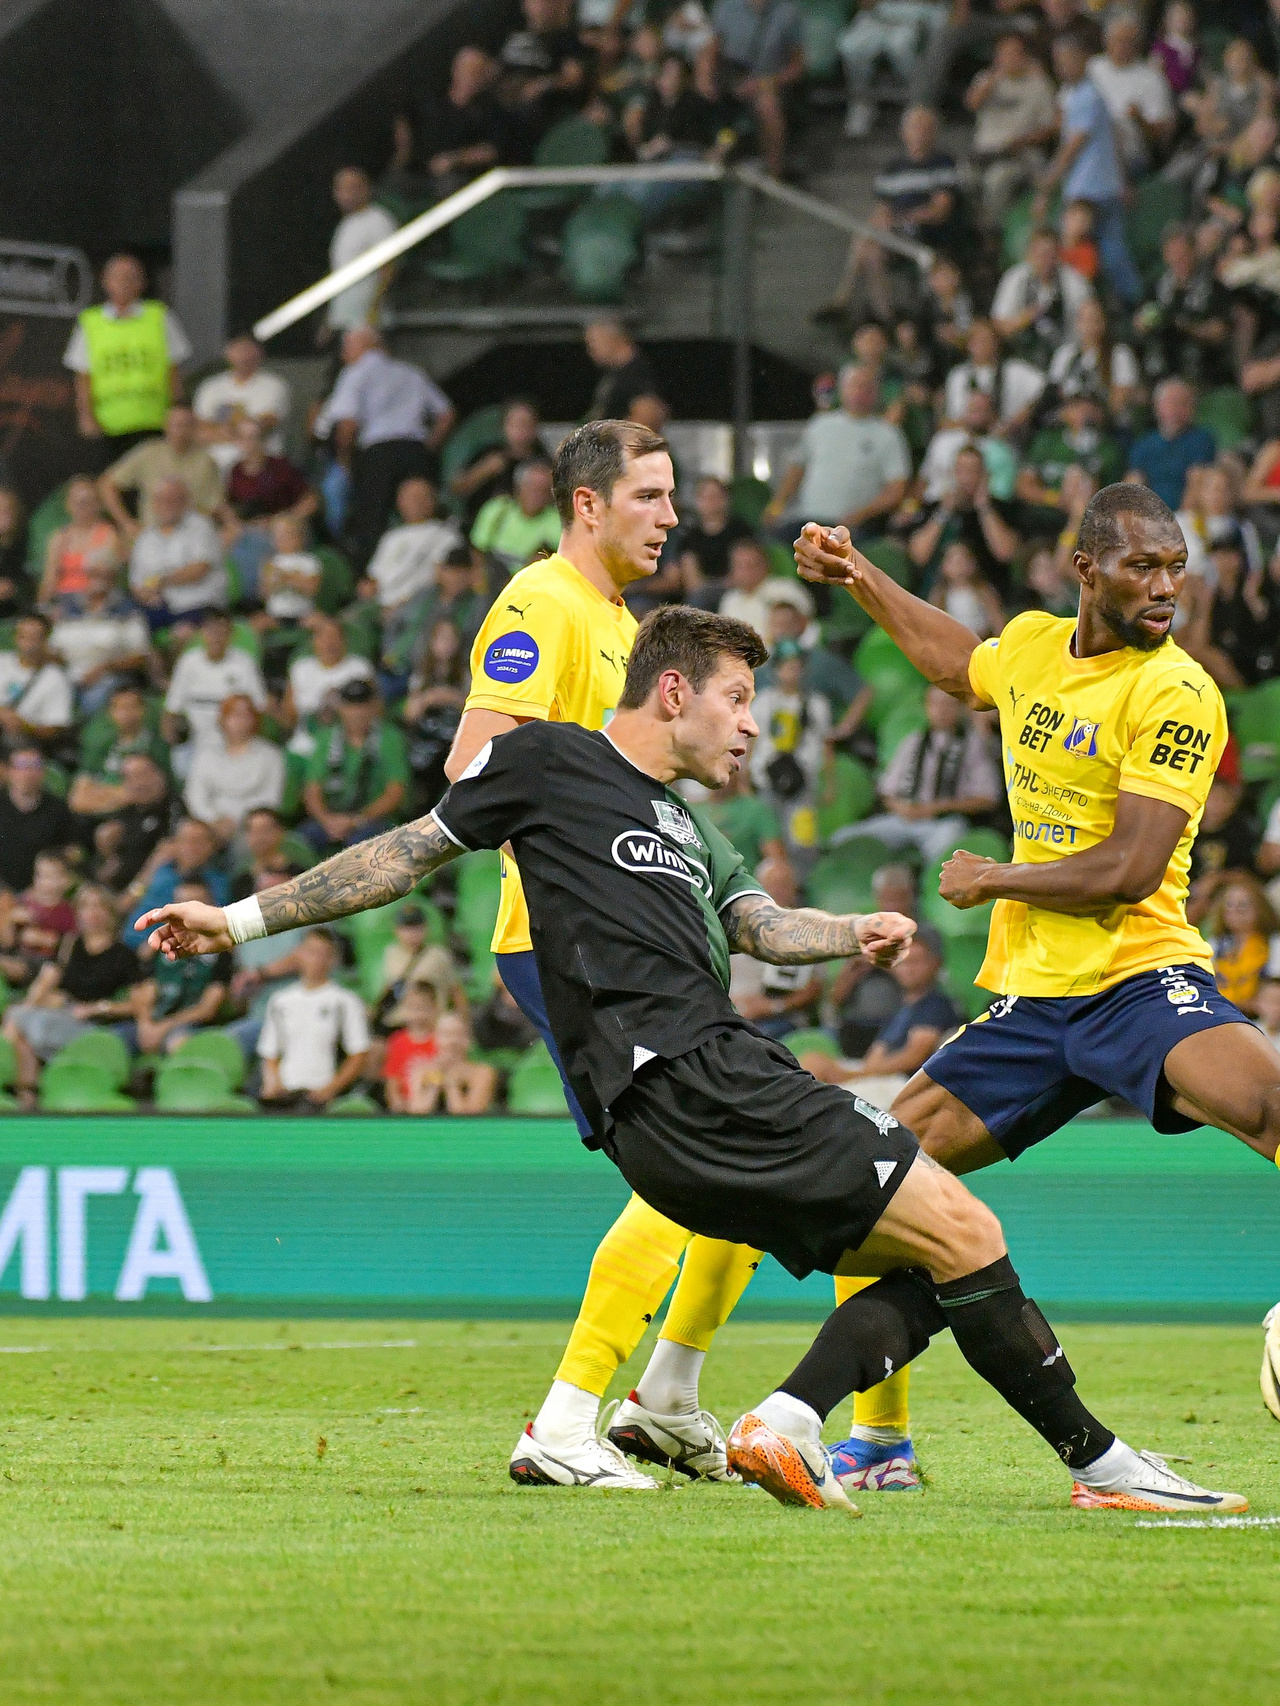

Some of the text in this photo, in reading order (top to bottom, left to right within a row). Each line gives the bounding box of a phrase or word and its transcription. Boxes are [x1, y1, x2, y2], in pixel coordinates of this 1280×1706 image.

[505, 649, 535, 659] МИР
[1025, 702, 1065, 731] FON
[1018, 724, 1053, 753] BET
[1155, 719, 1211, 752] FON
[1149, 743, 1204, 774] BET
[1013, 762, 1041, 793] ТНС
[1014, 819, 1080, 844] молет
